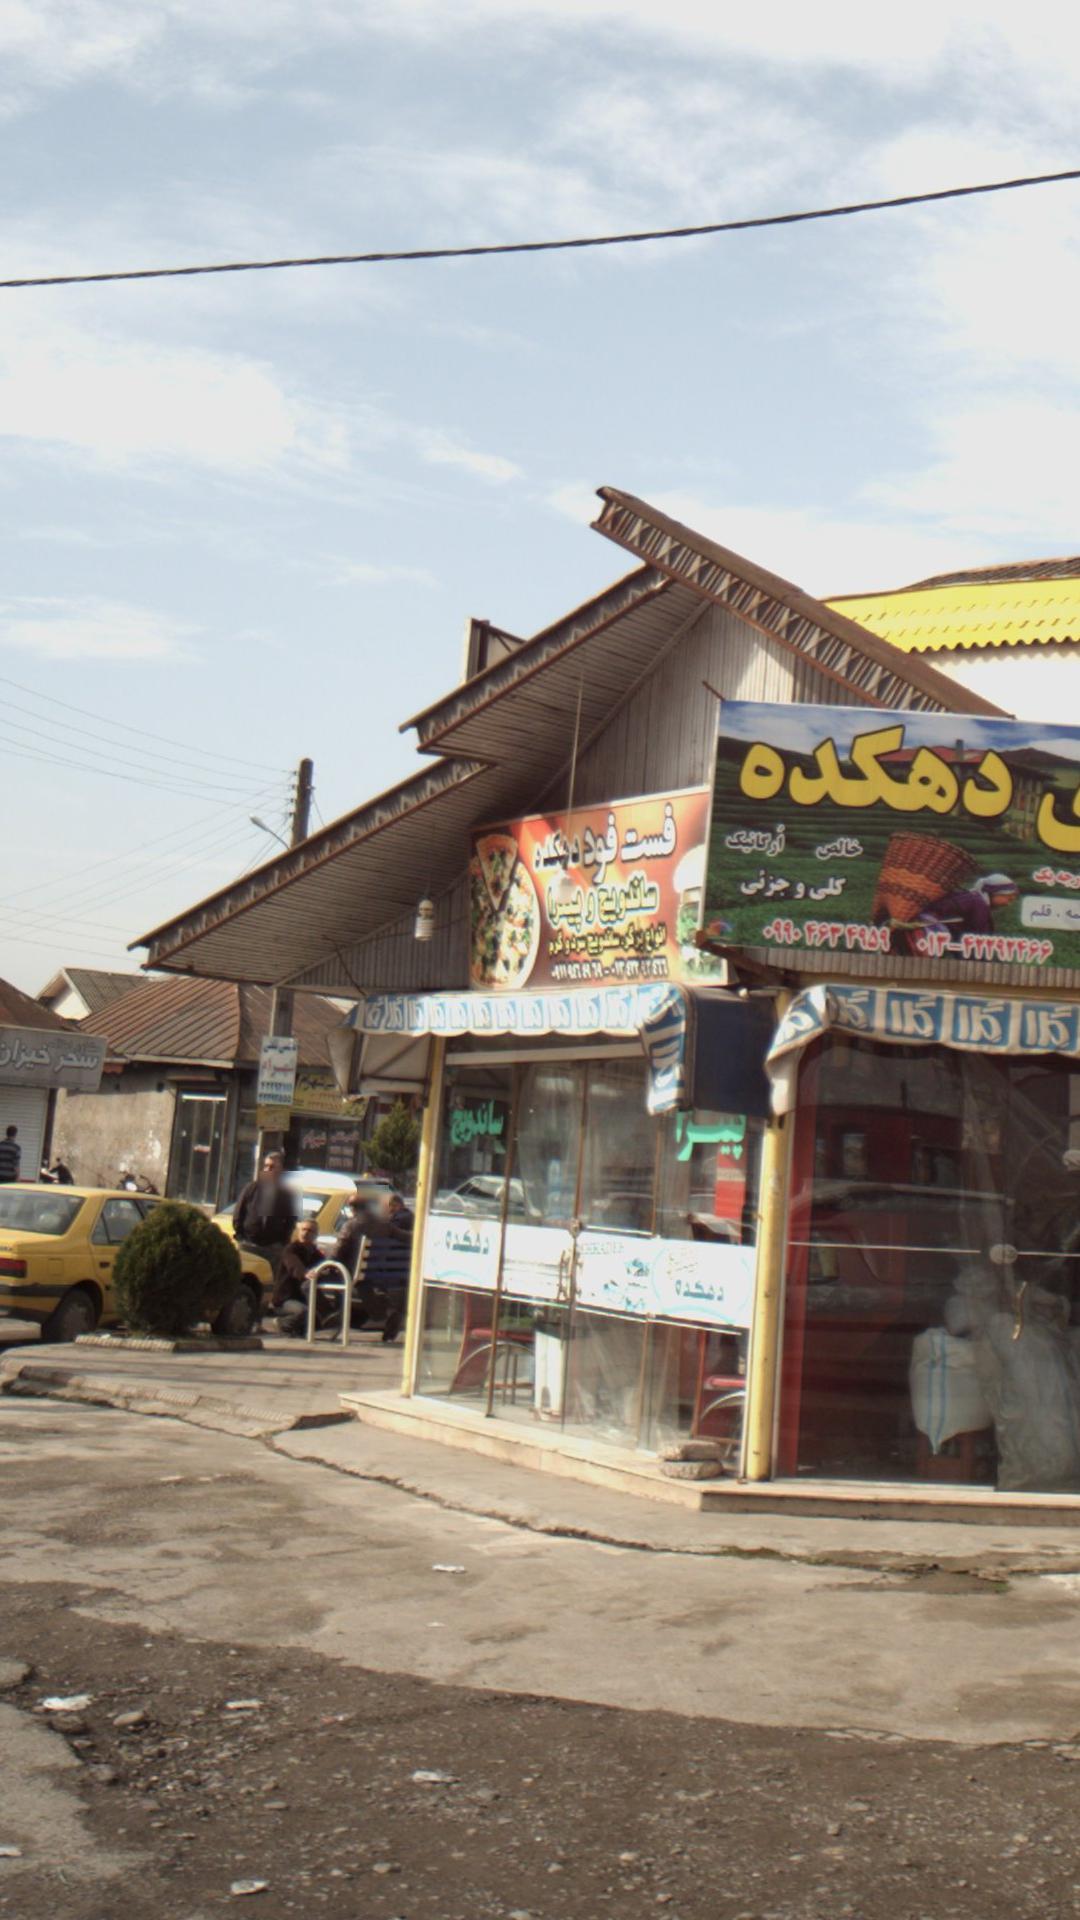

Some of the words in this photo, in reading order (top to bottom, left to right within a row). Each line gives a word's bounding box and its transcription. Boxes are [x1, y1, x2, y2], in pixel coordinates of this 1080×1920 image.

[739, 724, 1014, 818] دهکده
[621, 802, 676, 863] فست
[583, 812, 618, 885] فود
[816, 838, 864, 860] خالص
[794, 882, 805, 899] و
[809, 876, 846, 900] کلی
[53, 1052, 98, 1073] سحر
